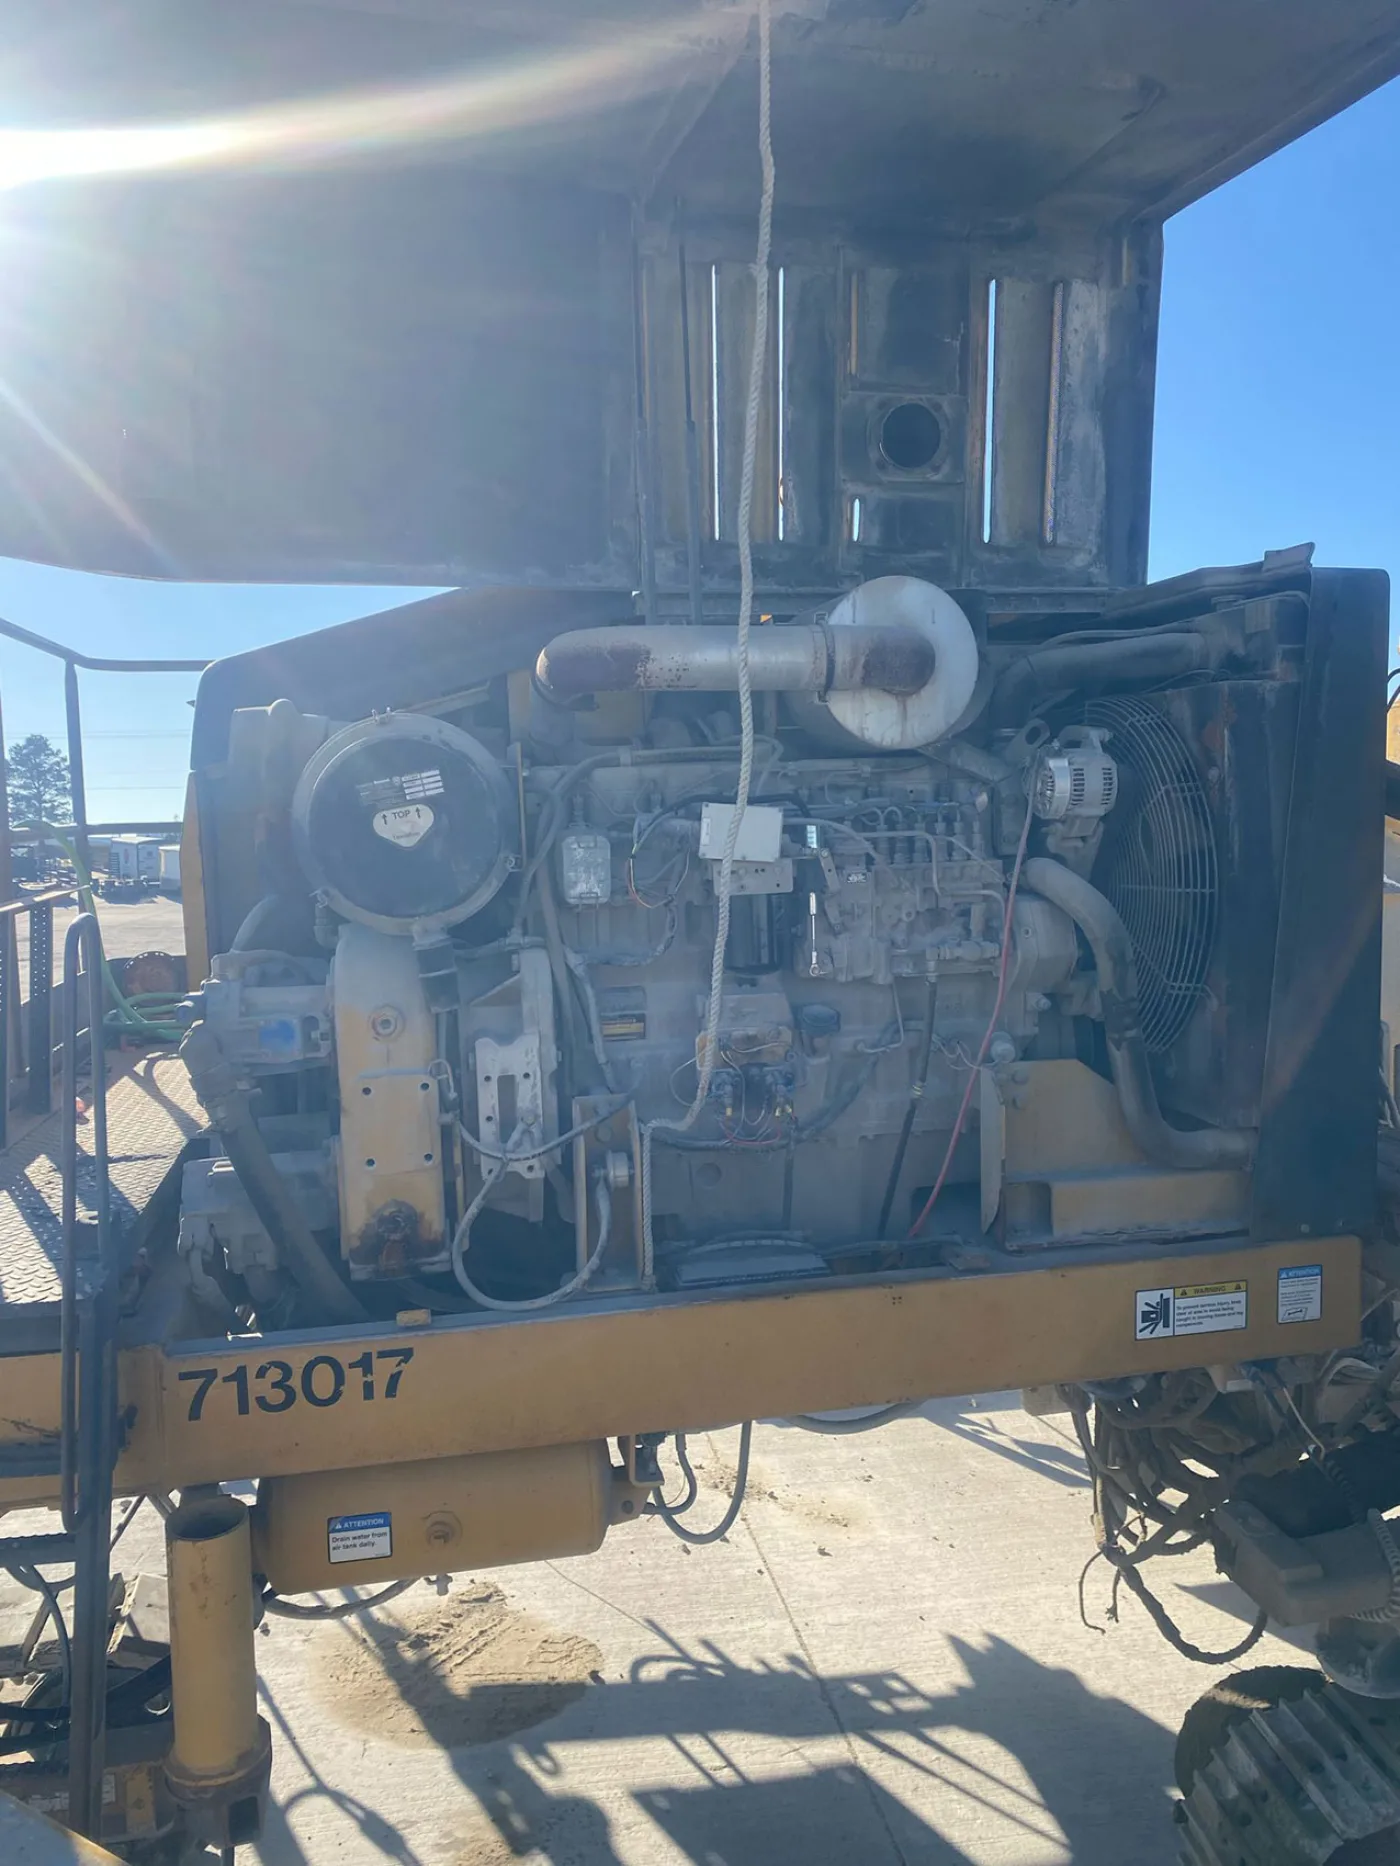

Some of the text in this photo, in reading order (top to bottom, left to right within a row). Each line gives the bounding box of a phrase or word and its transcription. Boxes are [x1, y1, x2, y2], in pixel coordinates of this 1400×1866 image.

[392, 810, 410, 820] TOP
[1193, 1285, 1226, 1295] WARNING
[178, 1347, 414, 1422] 713017
[344, 1518, 384, 1528] ATTENTION
